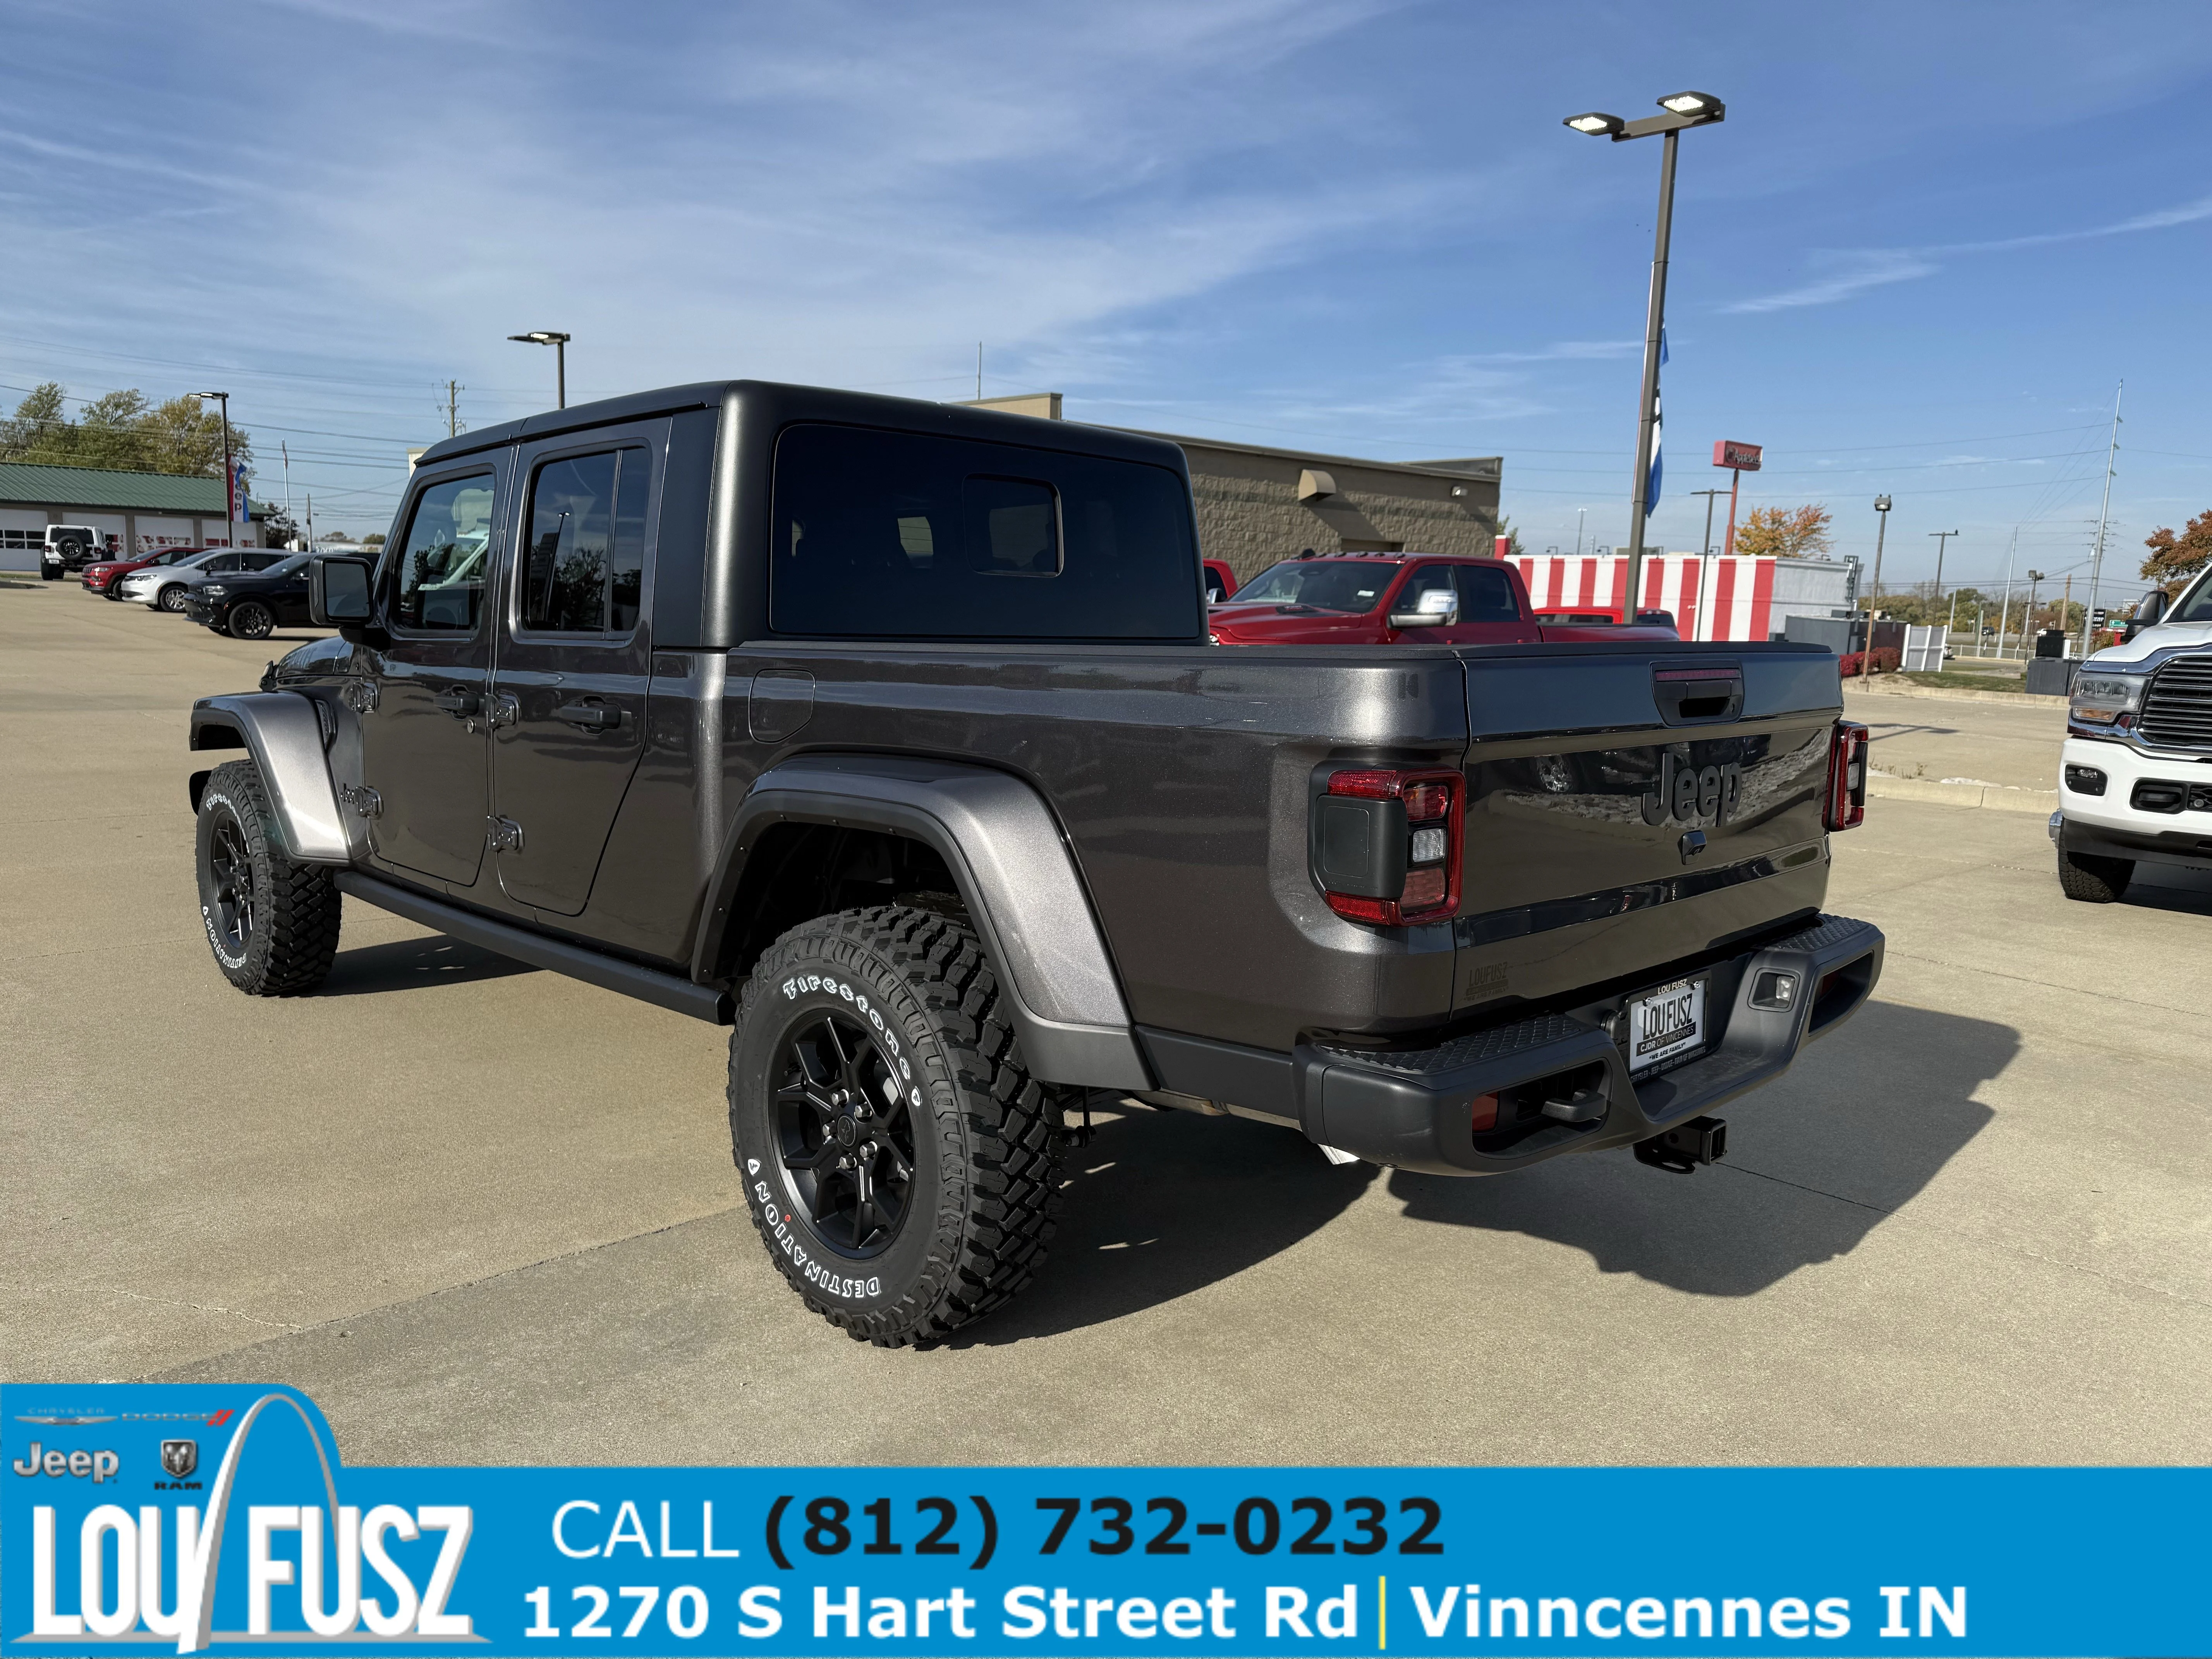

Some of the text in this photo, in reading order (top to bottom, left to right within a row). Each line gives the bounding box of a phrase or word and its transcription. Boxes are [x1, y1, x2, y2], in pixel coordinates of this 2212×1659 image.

[1641, 753, 1742, 827] Jeep
[1657, 979, 1687, 995] LOU FUSZ
[783, 974, 911, 1080] Firestone
[1640, 1025, 1693, 1052] CJDR OF VINCENNES
[1659, 1049, 1668, 1057] ARE
[755, 1180, 881, 1298] DESTINATION
